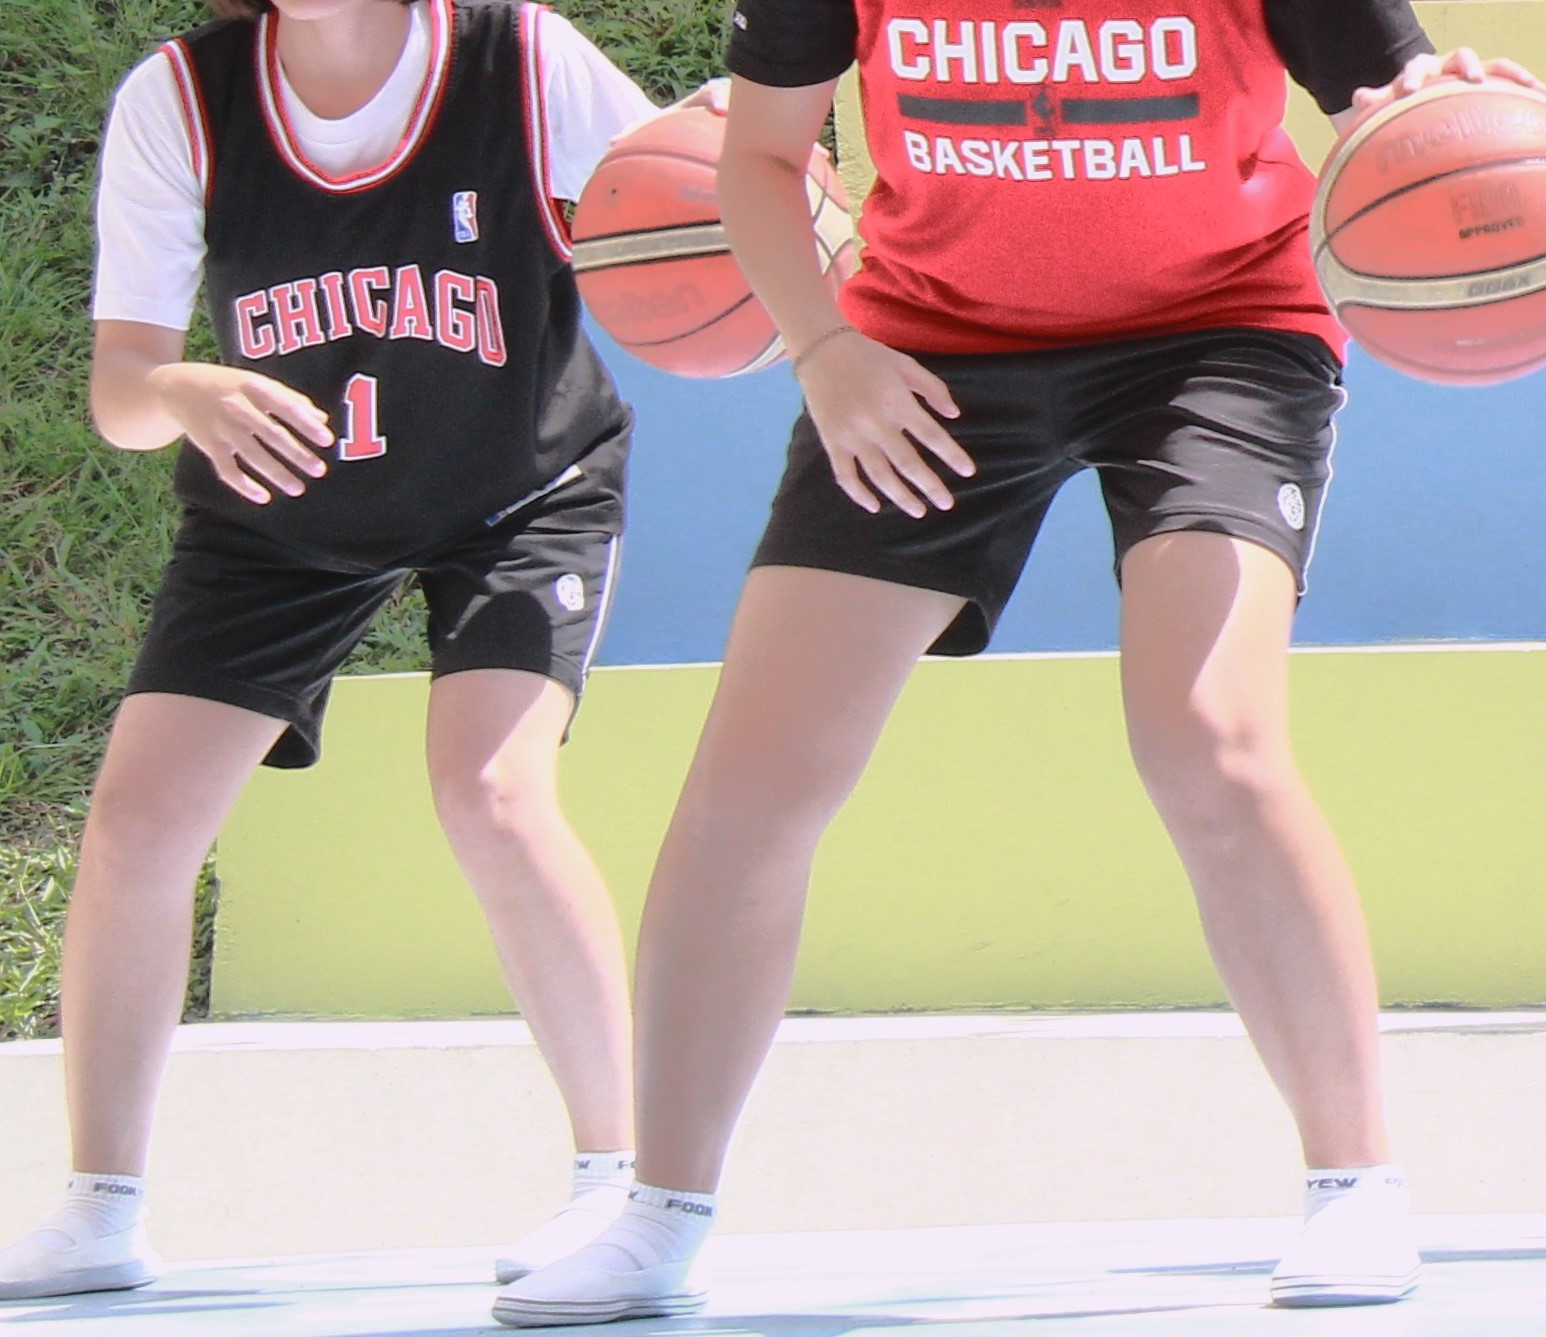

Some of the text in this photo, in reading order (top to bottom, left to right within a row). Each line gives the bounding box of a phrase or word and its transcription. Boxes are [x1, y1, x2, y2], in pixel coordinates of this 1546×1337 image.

[886, 14, 1199, 84] CHICAGO
[902, 129, 1207, 183] BASKETBALL
[235, 264, 507, 368] CHICAGO
[338, 373, 388, 463] 1
